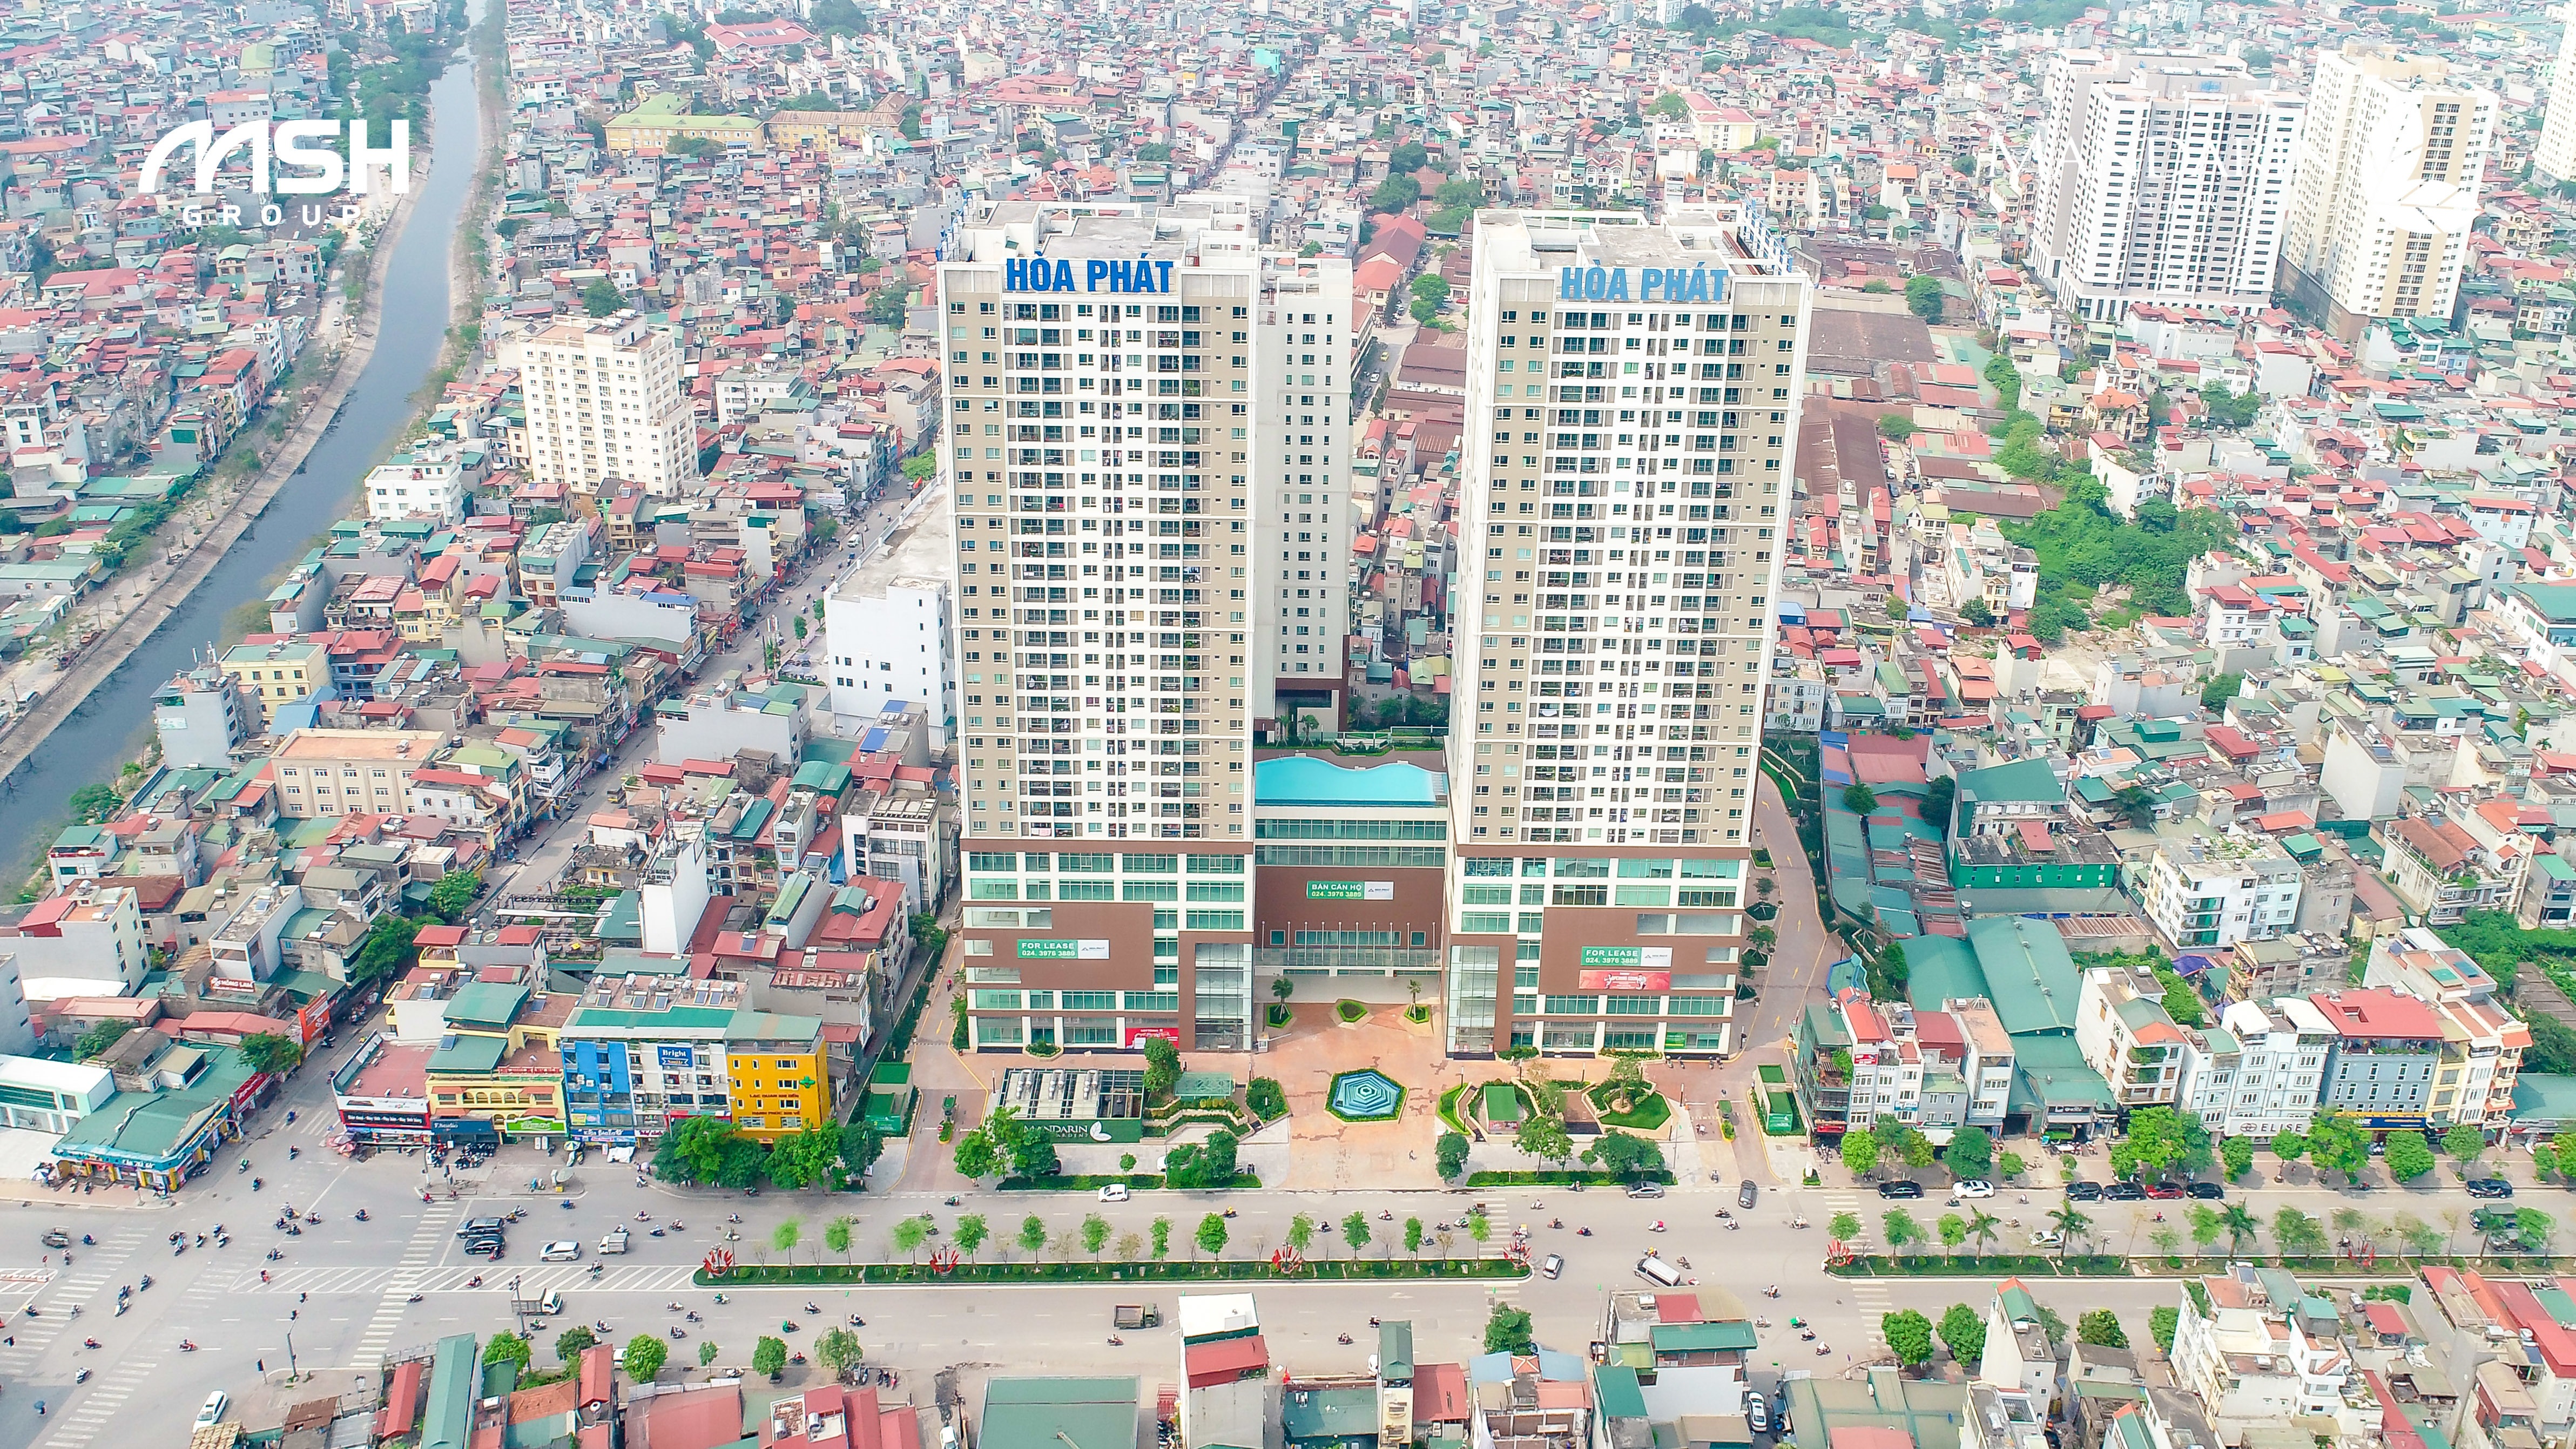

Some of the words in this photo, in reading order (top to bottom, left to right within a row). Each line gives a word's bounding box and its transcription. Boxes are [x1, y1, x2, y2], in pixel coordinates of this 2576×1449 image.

[1006, 251, 1076, 292] HÒA
[1087, 252, 1174, 293] PHÁT
[1561, 259, 1629, 300] HÒA
[1640, 261, 1729, 302] PHÁT
[662, 1049, 686, 1057] Bright
[2261, 1123, 2303, 1132] ELISE
